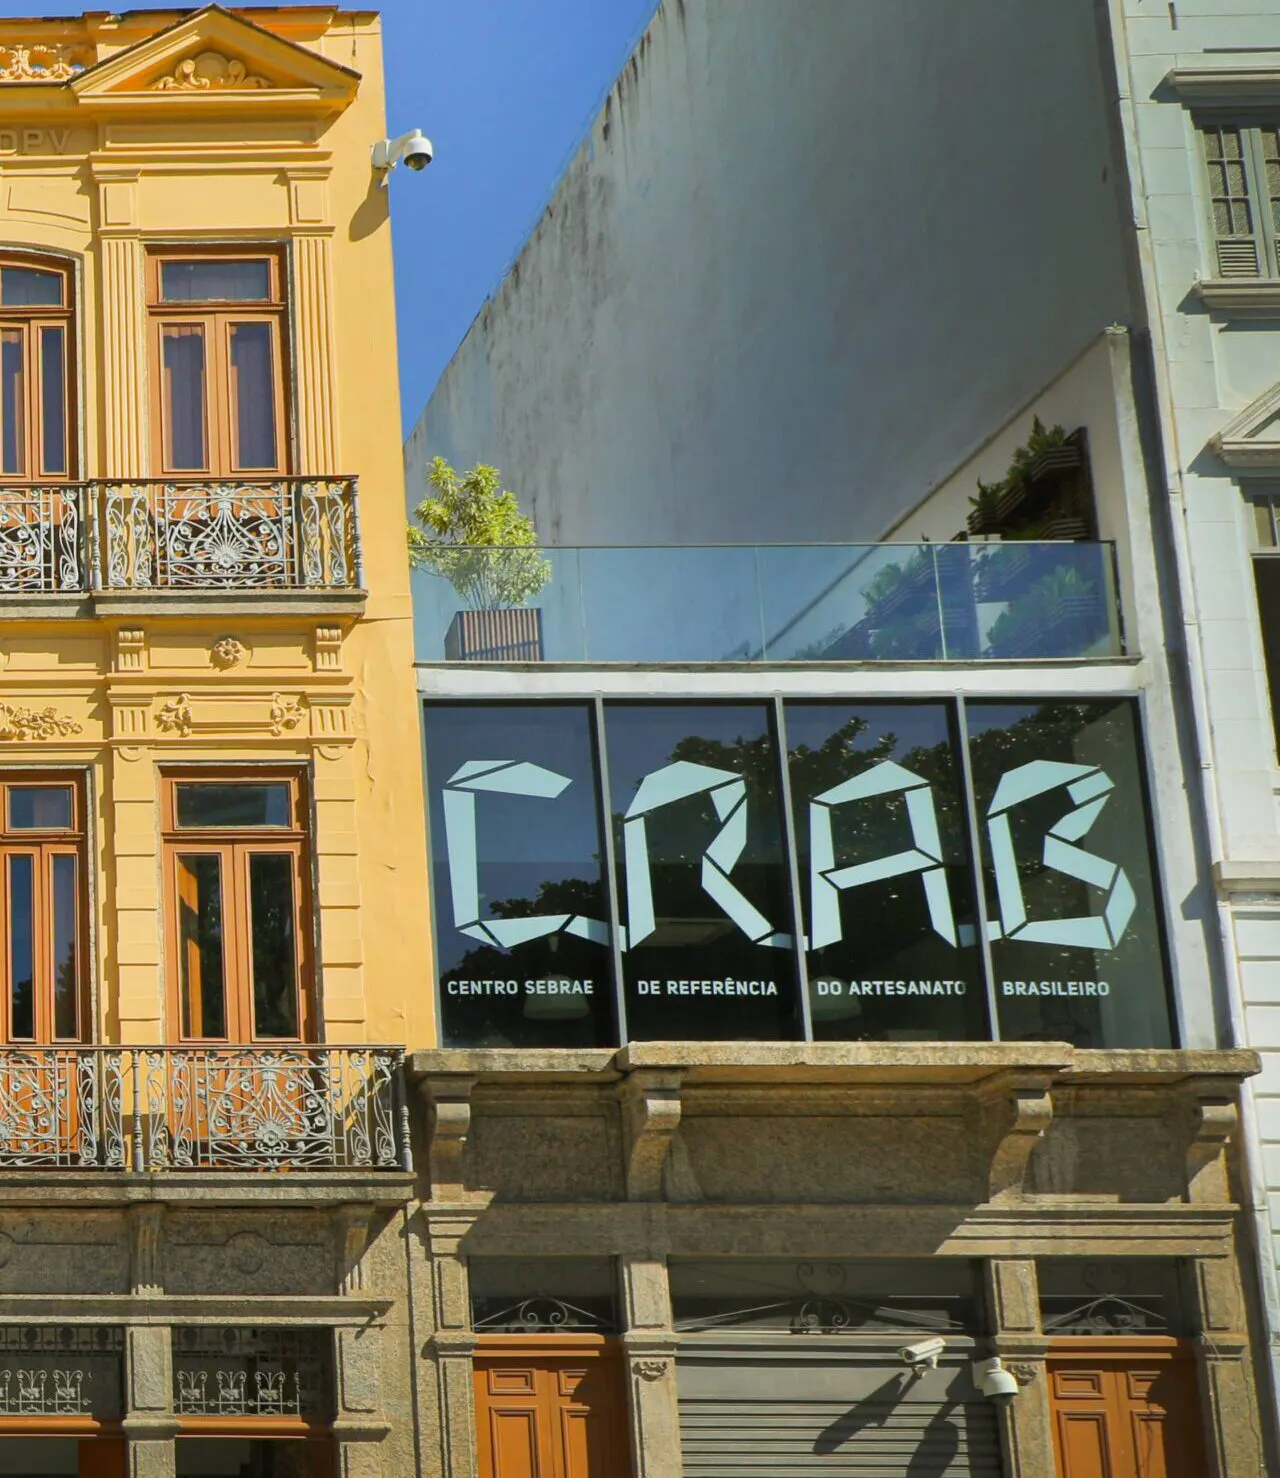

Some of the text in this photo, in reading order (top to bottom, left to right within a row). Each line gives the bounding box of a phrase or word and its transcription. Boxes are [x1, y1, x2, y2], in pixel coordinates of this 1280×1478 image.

[442, 760, 1137, 952] CRAB
[447, 977, 1110, 996] CENTRO SEBRAE DE REFERÊNCIA DO ARTESANATO BRASILEIRO
